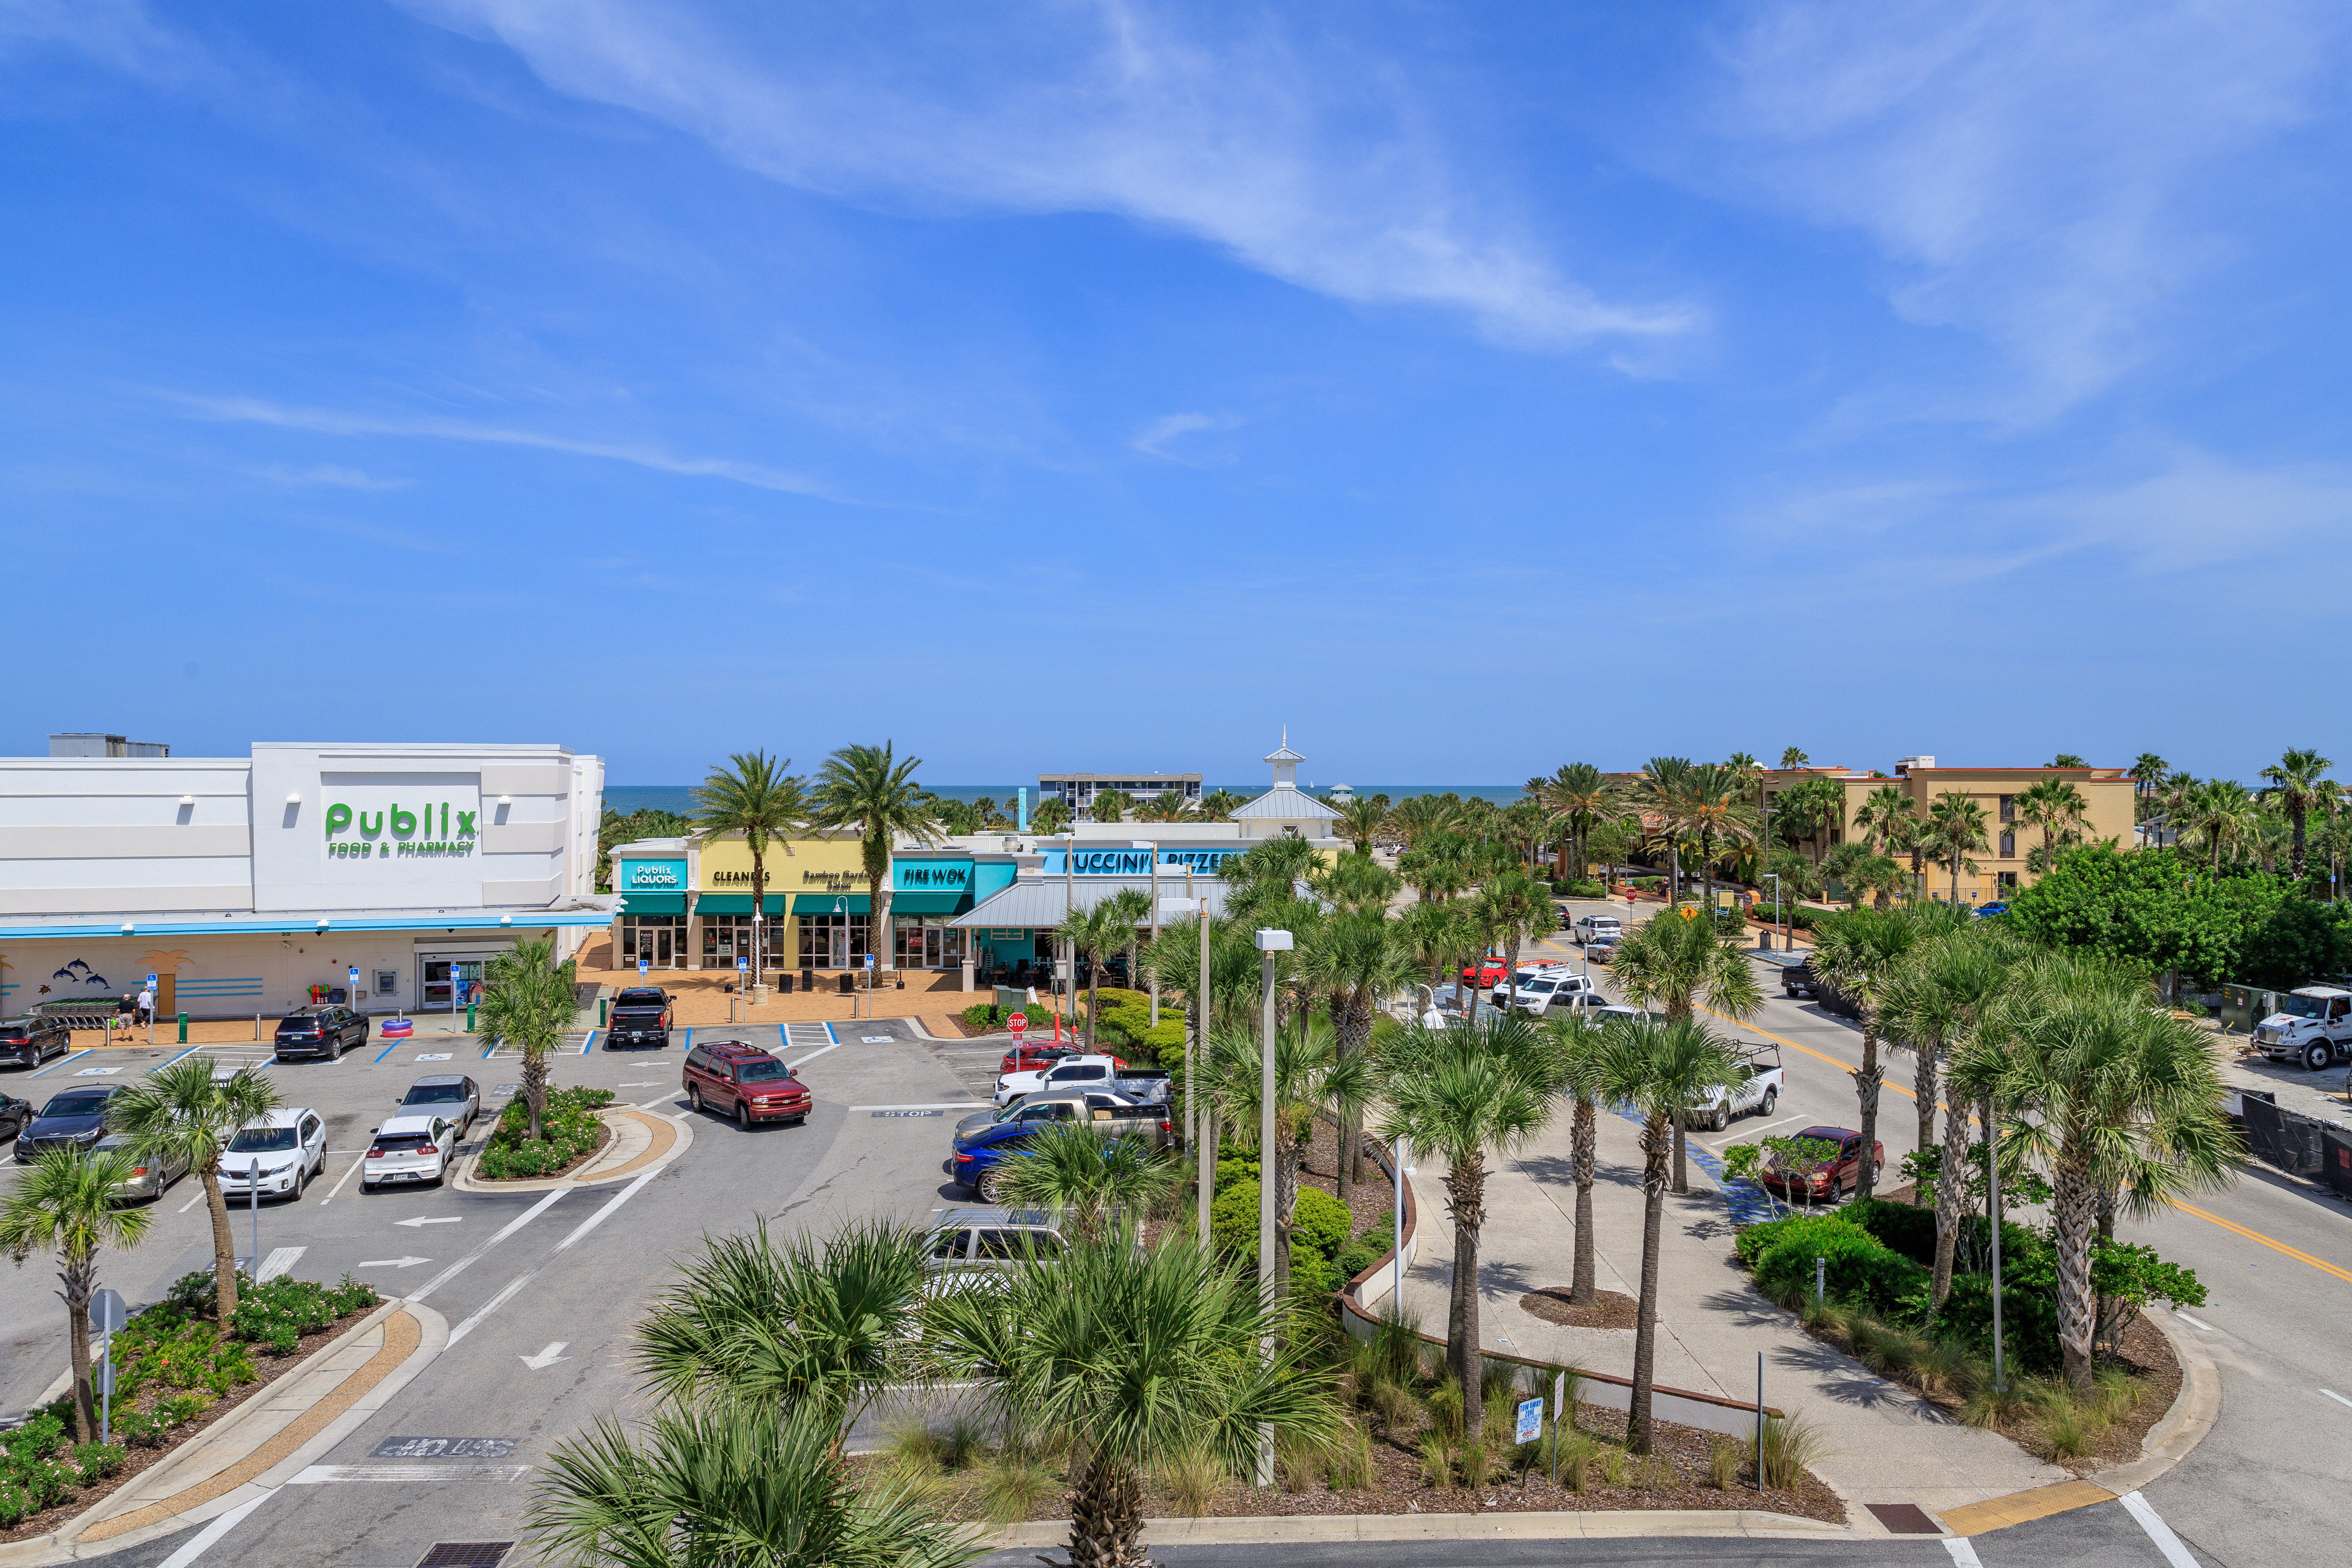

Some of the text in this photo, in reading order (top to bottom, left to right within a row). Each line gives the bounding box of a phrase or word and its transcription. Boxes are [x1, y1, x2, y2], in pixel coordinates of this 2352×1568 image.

[327, 802, 476, 834] Publix
[329, 841, 475, 852] FOOD & PHARMACY
[1169, 853, 1235, 869] PIZZE
[637, 865, 671, 874] Publix
[843, 870, 868, 878] Garde
[905, 869, 966, 880] FIRE WOK
[632, 875, 677, 884] LIQUORS
[714, 871, 770, 881] CLEANS
[1520, 1399, 1542, 1412] TOW AWAY
[1525, 1408, 1534, 1417] ZONE
